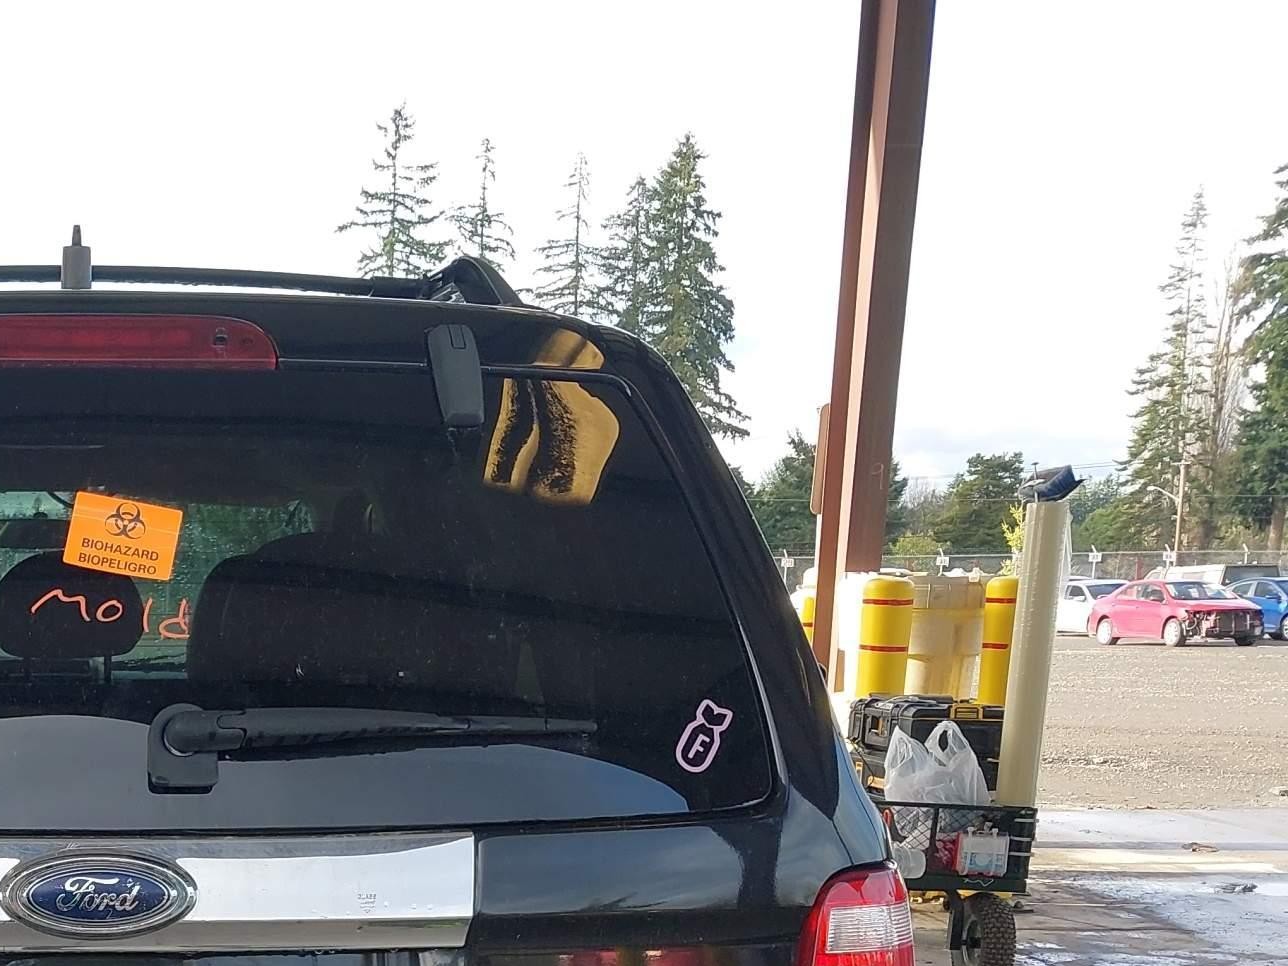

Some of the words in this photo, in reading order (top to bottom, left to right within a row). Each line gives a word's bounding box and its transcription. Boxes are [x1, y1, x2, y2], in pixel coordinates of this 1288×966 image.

[81, 537, 159, 562] BIOHAZARD
[78, 552, 157, 575] BIOPELIGRO
[687, 733, 711, 759] F
[55, 876, 142, 912] Ford
